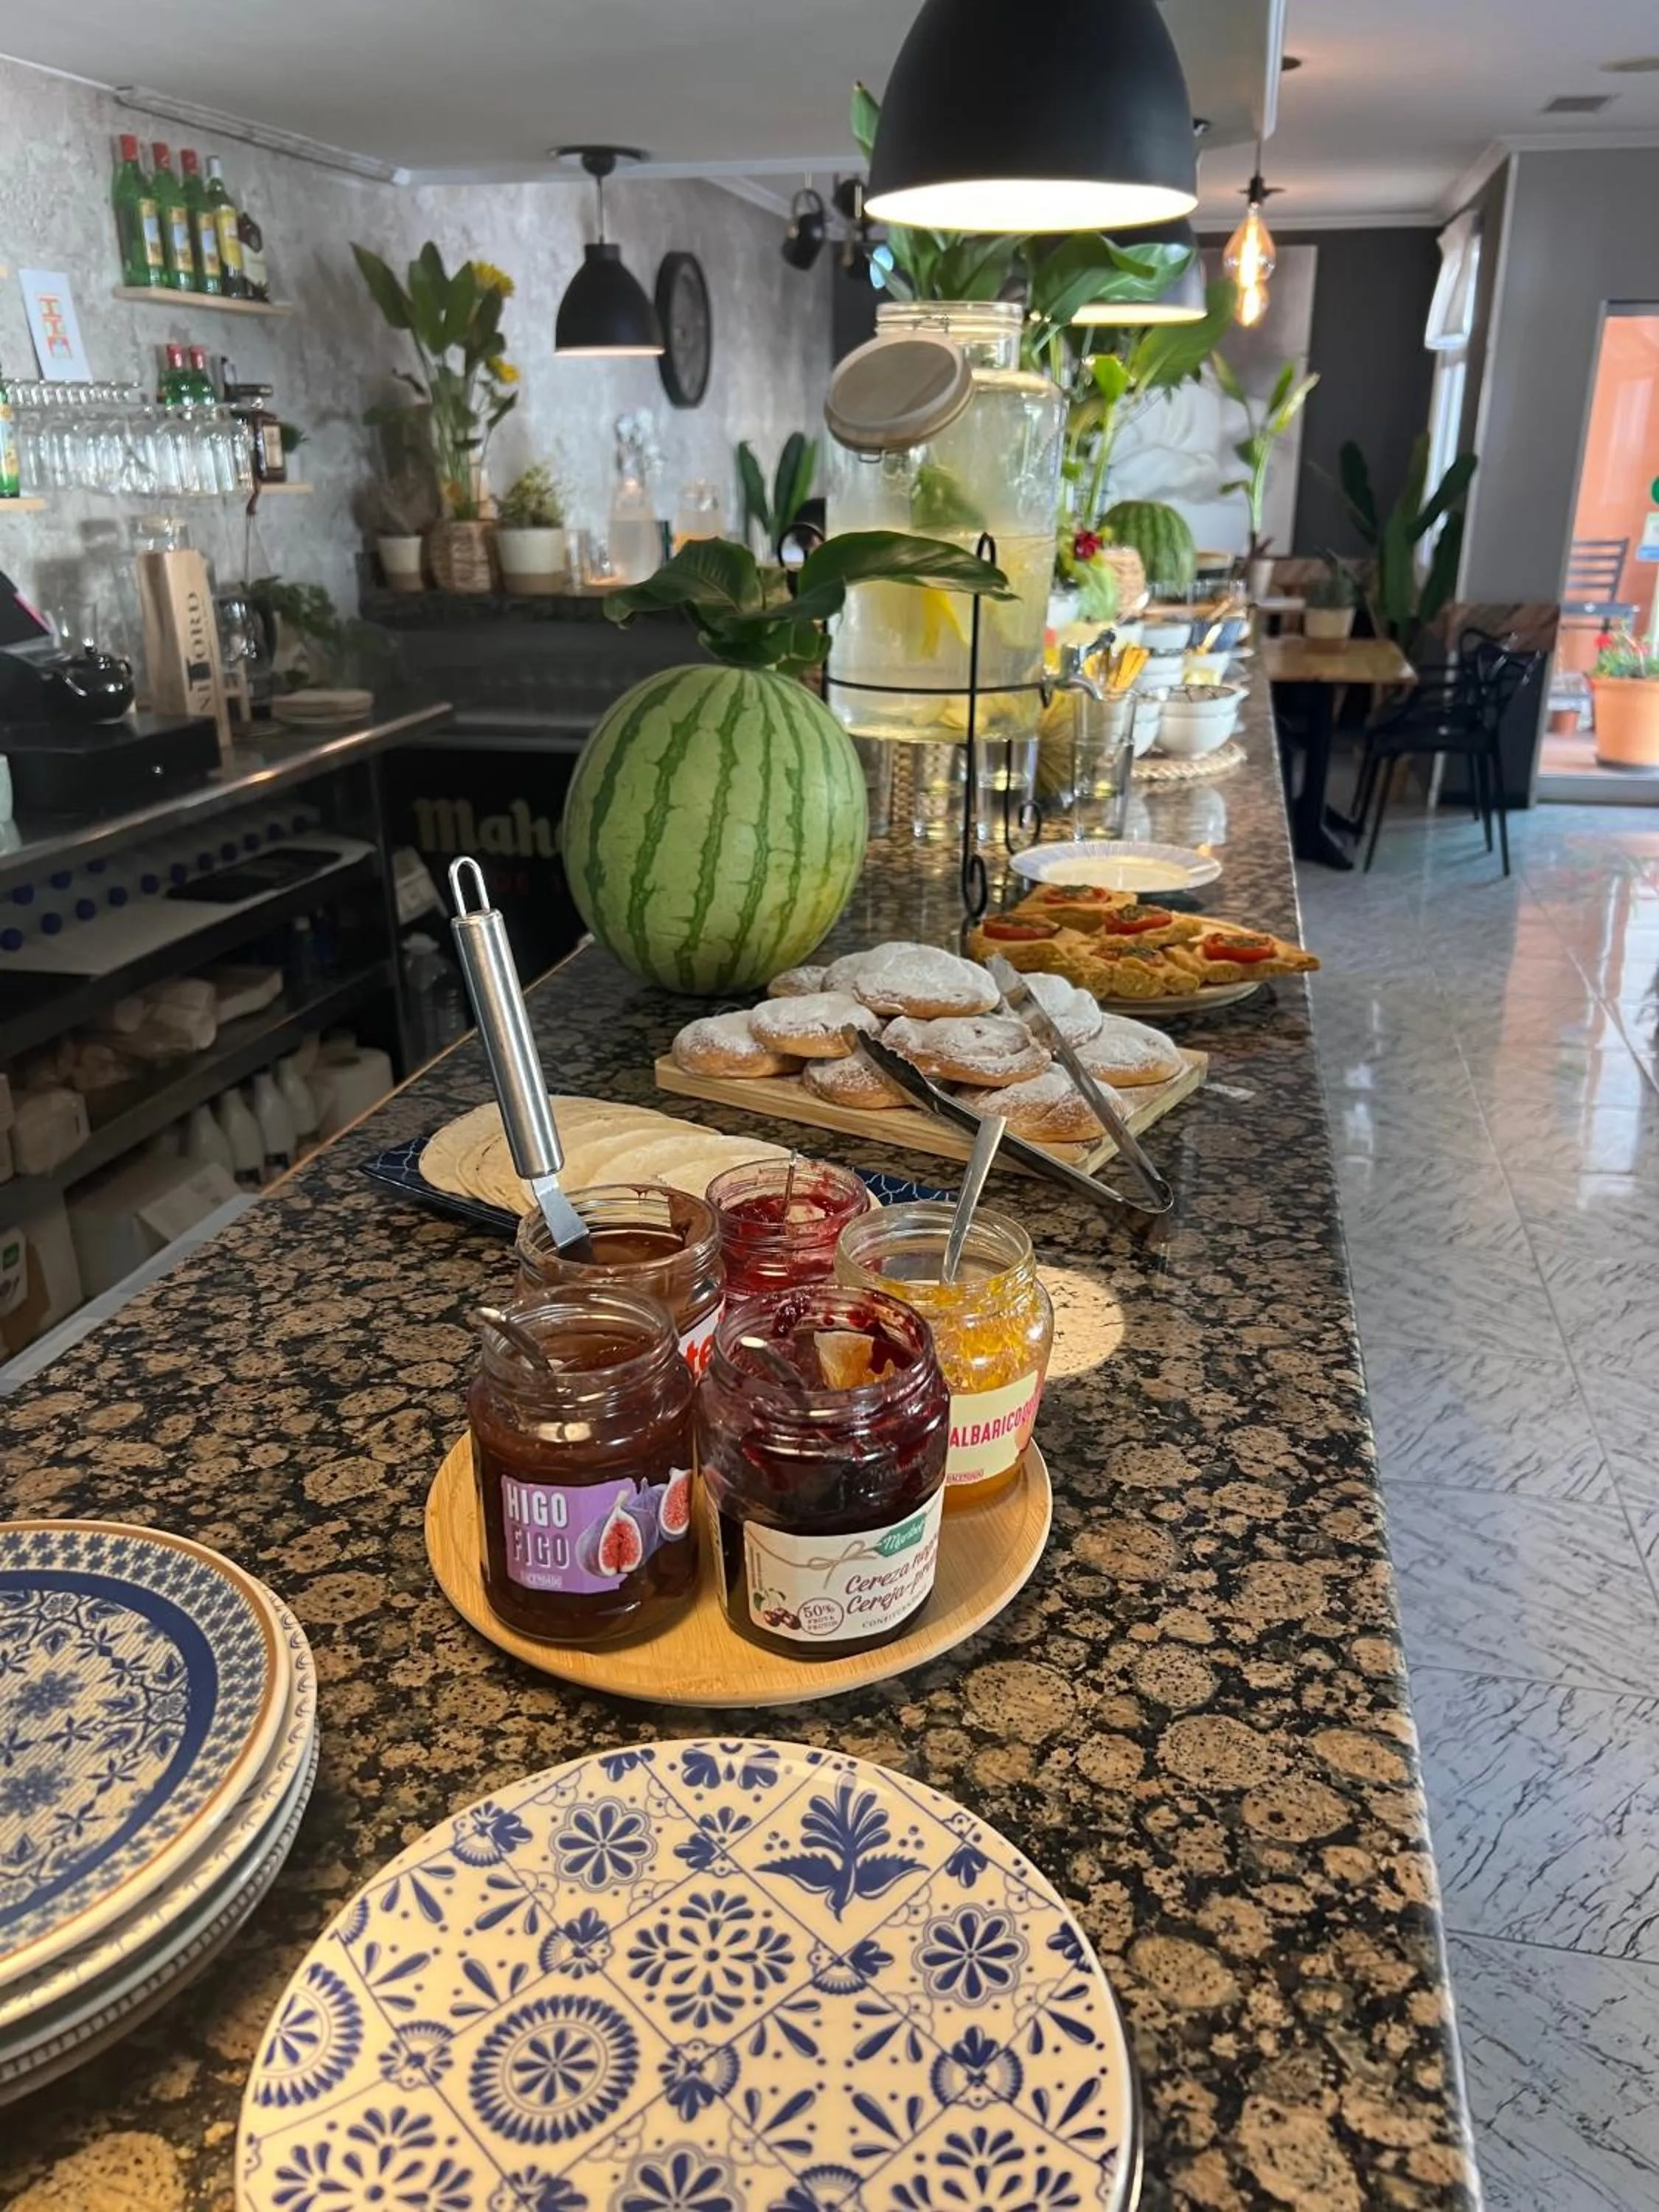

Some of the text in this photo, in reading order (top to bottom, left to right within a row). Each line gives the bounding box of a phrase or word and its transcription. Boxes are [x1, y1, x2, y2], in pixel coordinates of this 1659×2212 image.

[507, 1482, 568, 1528] HIGO
[513, 1529, 570, 1570] FIGO
[846, 1562, 910, 1595] Cereza
[802, 1604, 835, 1619] 50%
